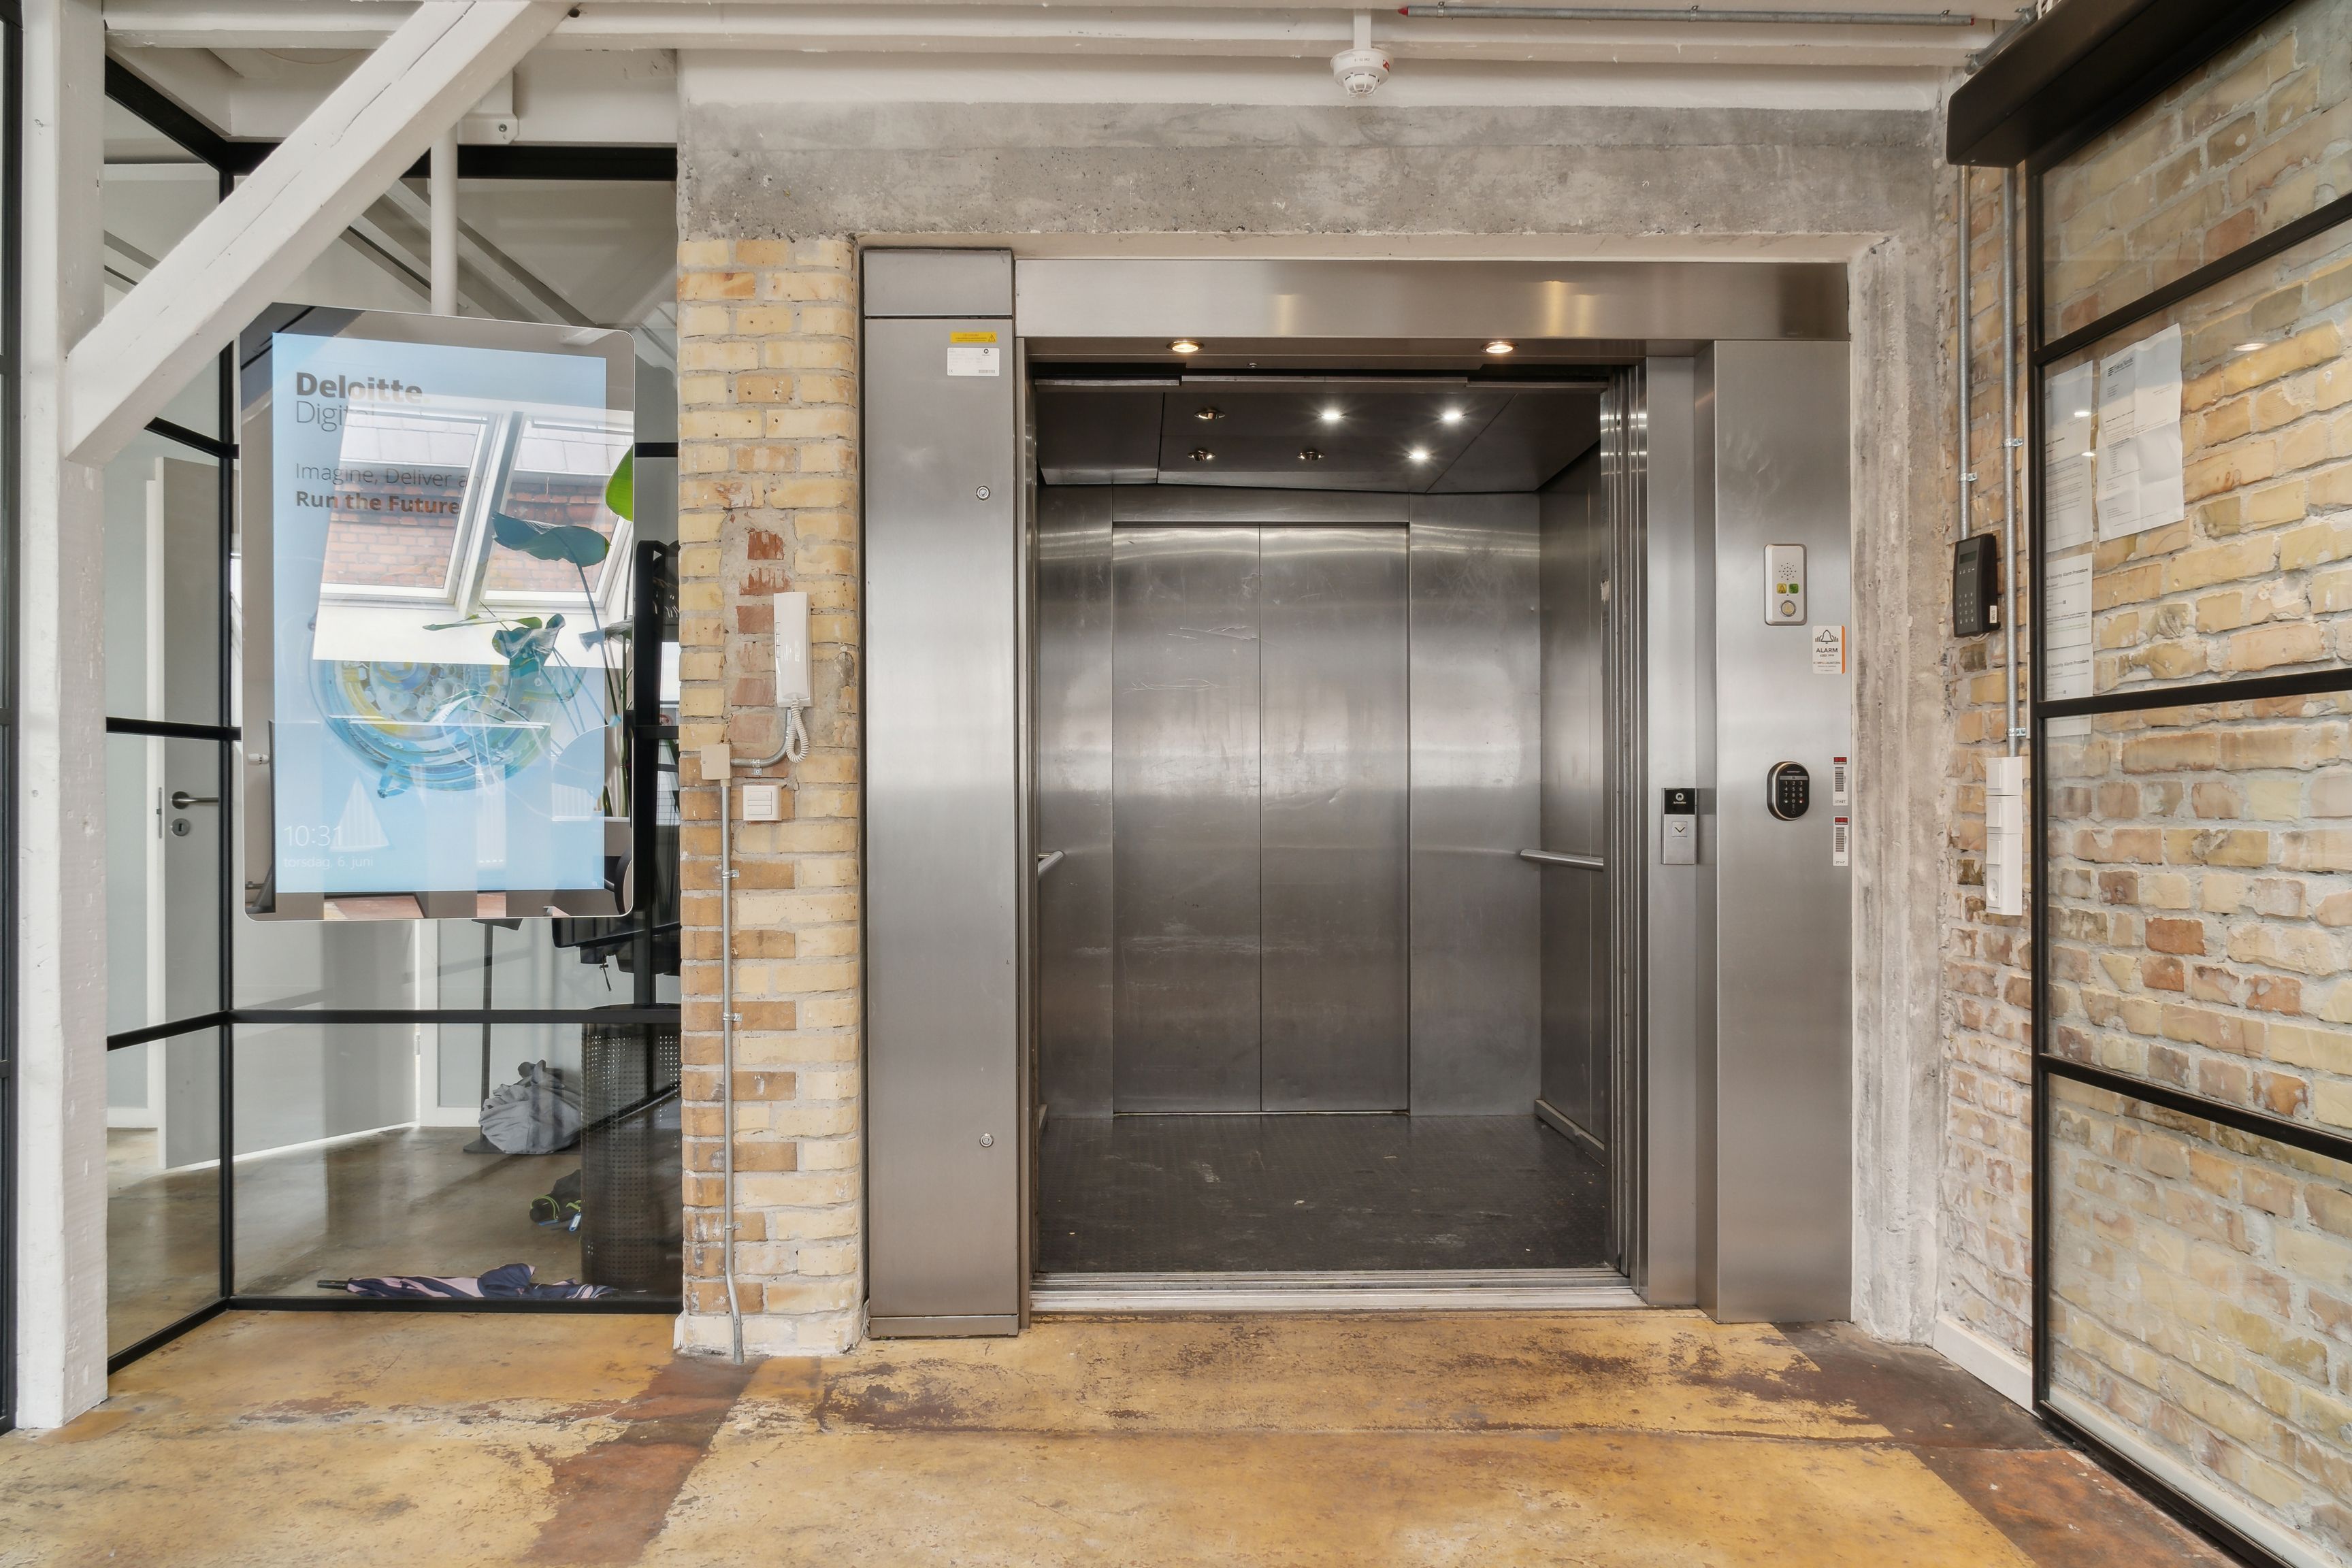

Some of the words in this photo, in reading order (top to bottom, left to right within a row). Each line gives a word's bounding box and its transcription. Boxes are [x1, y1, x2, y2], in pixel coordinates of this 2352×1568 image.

[296, 463, 378, 485] Imagine,
[386, 468, 452, 487] Deliver
[297, 491, 338, 508] Run
[345, 493, 382, 510] the
[389, 495, 460, 514] Future
[283, 825, 342, 847] 10:31
[283, 856, 333, 870] torsdag,
[350, 856, 374, 870] juni
